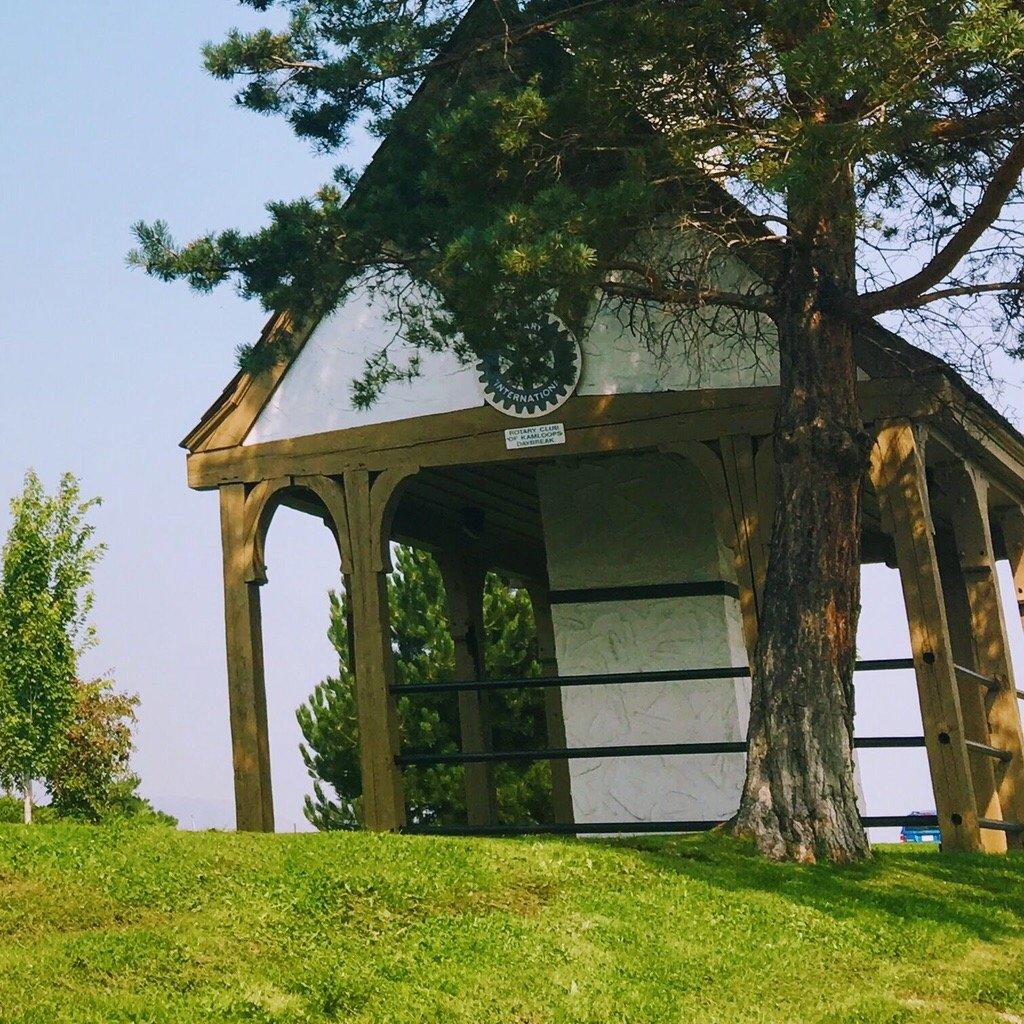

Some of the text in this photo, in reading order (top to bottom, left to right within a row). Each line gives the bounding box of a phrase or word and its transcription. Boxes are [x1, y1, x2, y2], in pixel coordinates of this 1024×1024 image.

[493, 379, 559, 403] INTERNATION
[508, 425, 560, 436] ROTARY CLUB
[520, 430, 564, 440] KAMLOOPS
[516, 437, 555, 447] DAYBREAK
